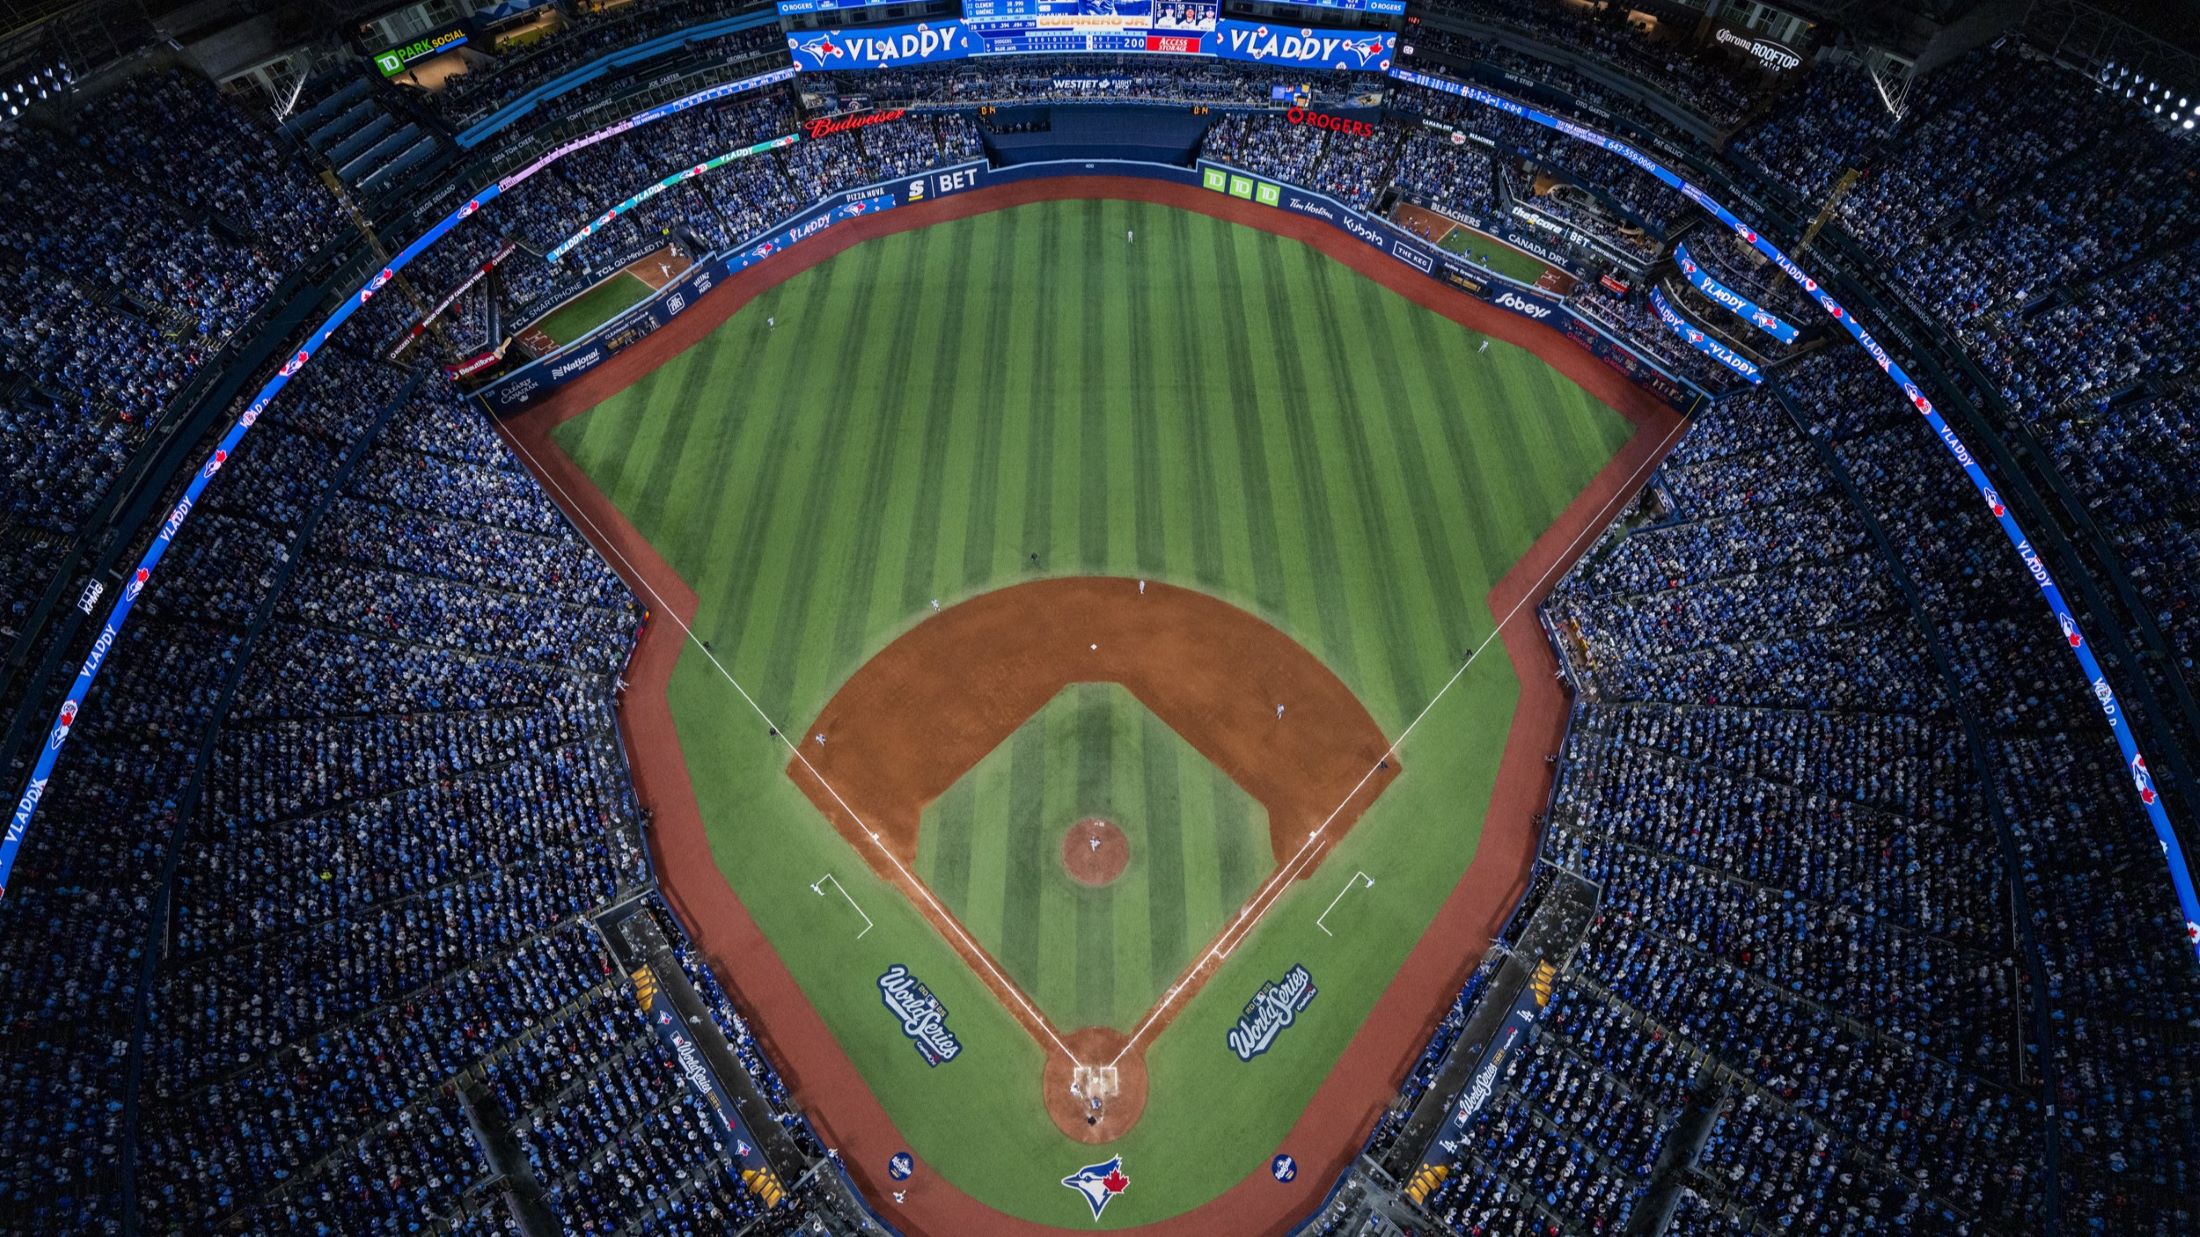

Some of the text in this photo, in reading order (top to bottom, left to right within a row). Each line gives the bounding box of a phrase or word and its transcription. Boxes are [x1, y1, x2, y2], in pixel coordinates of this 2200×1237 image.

[1377, 3, 1402, 11] ROGERS
[377, 29, 466, 71] TD PARK SOCIAL
[845, 26, 957, 61] VLADDY
[1160, 37, 1187, 46] ACCESS
[1230, 29, 1342, 61] VLADDY
[1716, 28, 1799, 70] Corona ROOFTOP
[659, 73, 680, 84] CARTER
[1760, 60, 1780, 72] PATIO
[1053, 80, 1098, 90] WESTJET
[803, 108, 905, 139] Budweiser
[1307, 111, 1374, 138] ROGERS
[720, 147, 753, 163] VLADDY
[1608, 141, 1656, 172] 647-559-0060
[939, 169, 977, 192] BET
[1206, 172, 1223, 187] TD
[1233, 180, 1249, 194] TD
[846, 187, 884, 202] PIZZA NOVA
[1260, 187, 1277, 201] TD
[1289, 197, 1333, 220] Tim Hortons
[1431, 202, 1481, 228] BLEACHERS
[1513, 206, 1563, 234] theScore
[789, 214, 831, 242] VLADDY
[1344, 216, 1383, 246] Kubota
[1570, 233, 1590, 248] BET
[553, 232, 584, 257] VLADDY
[1398, 247, 1427, 267] THE KEG
[1508, 233, 1569, 268] CANADA DRY
[596, 262, 615, 278] TCL
[653, 239, 665, 250] TV
[1774, 253, 1807, 286] VLADDY
[693, 272, 710, 288] HEINZ
[699, 282, 711, 295] MAYO
[1701, 276, 1746, 311] VLADDY
[510, 316, 529, 330] TCL
[528, 282, 583, 318] SMARTPHONE
[1495, 292, 1551, 318] Sobeys
[1655, 294, 1682, 328] VLADDY
[563, 348, 600, 374] National
[1711, 344, 1757, 376] VLADDY
[501, 377, 531, 397] CLEARLY
[501, 381, 539, 404] CANADIAN
[1940, 424, 1975, 468] VLADDY
[160, 495, 193, 543] VLADDY
[2017, 540, 2052, 588] VLADDY
[83, 583, 104, 616] KPMG
[79, 623, 117, 678] VLADDY
[4, 777, 42, 842] VLADDY
[880, 967, 959, 1059] World Series
[918, 985, 947, 1017] 20 25
[1229, 966, 1309, 1059] World Series
[1245, 1004, 1255, 1014] 20
[1517, 1009, 1535, 1023] LA
[677, 1041, 701, 1074] World
[686, 1067, 712, 1094] Series
[1460, 1085, 1484, 1115] World
[1476, 1062, 1497, 1096] Series
[1439, 1139, 1458, 1154] LA
